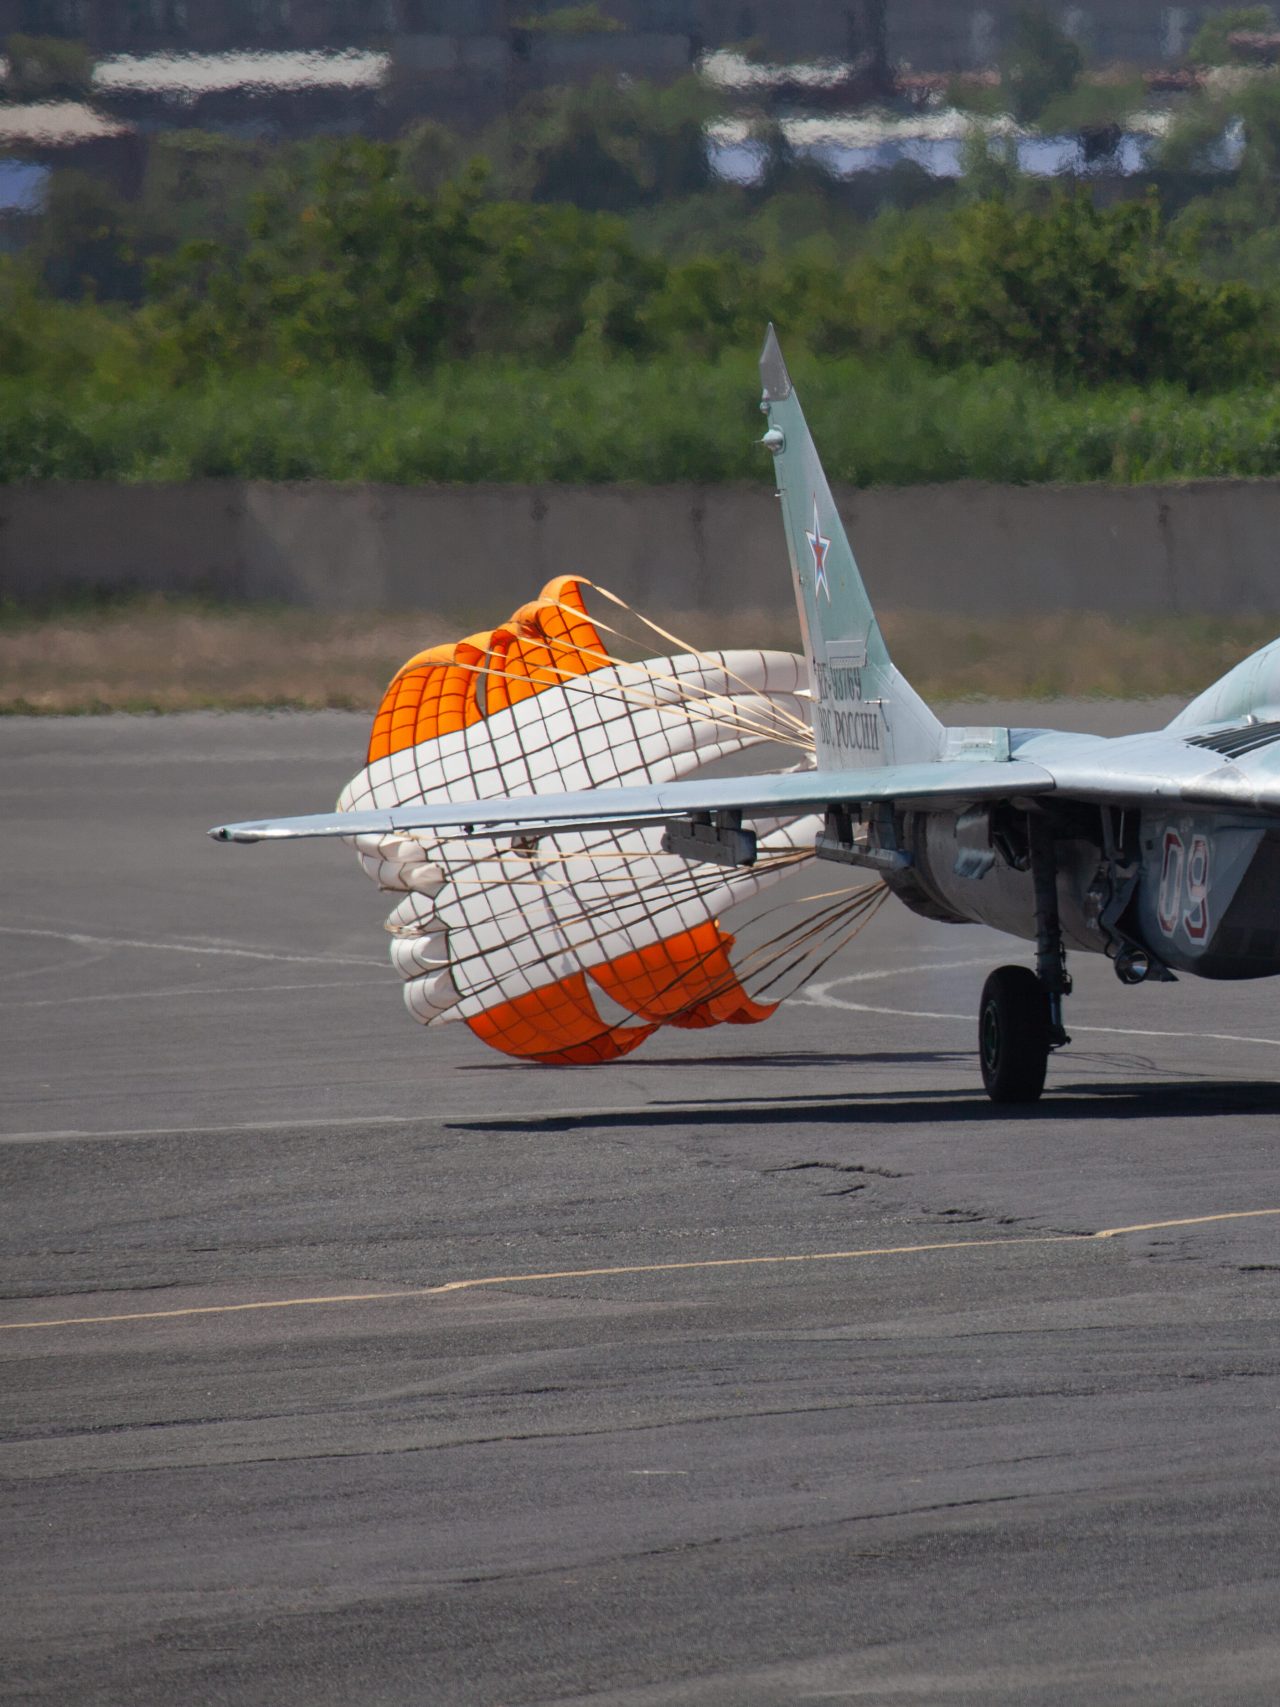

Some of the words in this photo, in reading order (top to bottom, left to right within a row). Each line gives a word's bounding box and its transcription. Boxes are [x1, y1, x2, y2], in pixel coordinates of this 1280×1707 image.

[818, 707, 835, 746] ВВС
[834, 710, 879, 750] РОССИИ
[1157, 826, 1209, 945] 09
